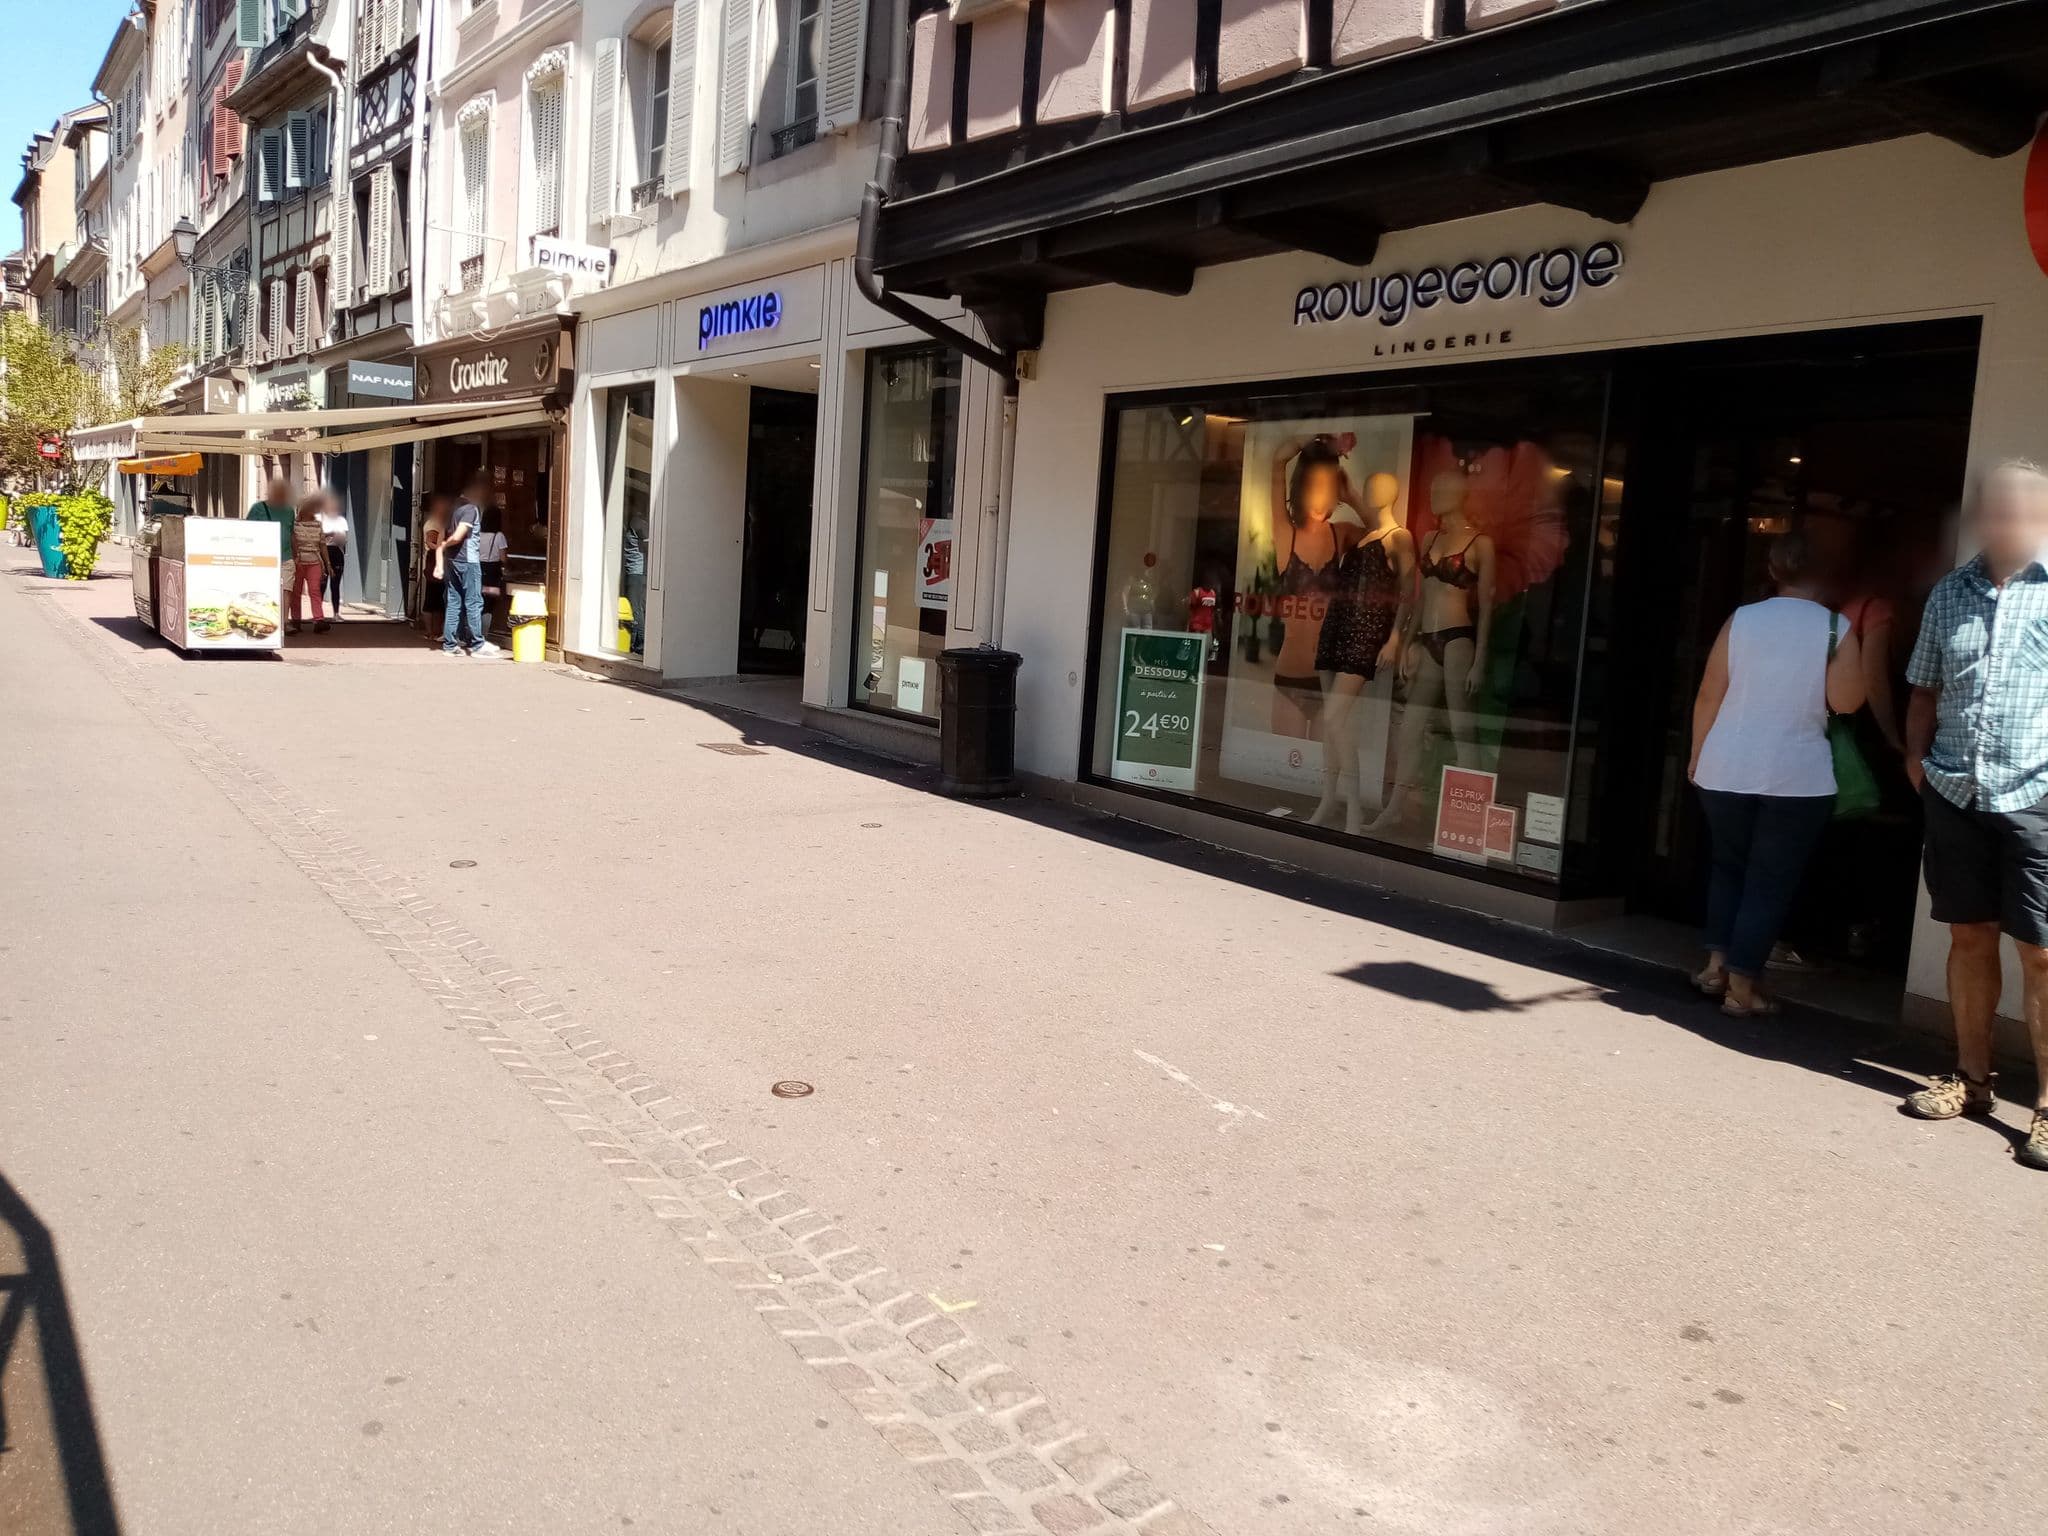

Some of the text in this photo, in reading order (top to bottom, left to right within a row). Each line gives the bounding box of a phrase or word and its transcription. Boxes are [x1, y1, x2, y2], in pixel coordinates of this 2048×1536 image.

[539, 249, 606, 272] pimkie
[699, 292, 781, 350] pimkie
[1374, 330, 1513, 356] LINGERIE
[352, 373, 413, 388] NAF NAF
[450, 351, 509, 393] Croustine
[1135, 666, 1188, 680] DESSOUS
[1450, 787, 1486, 801] LES PRIX
[1451, 798, 1481, 813] RONDS
